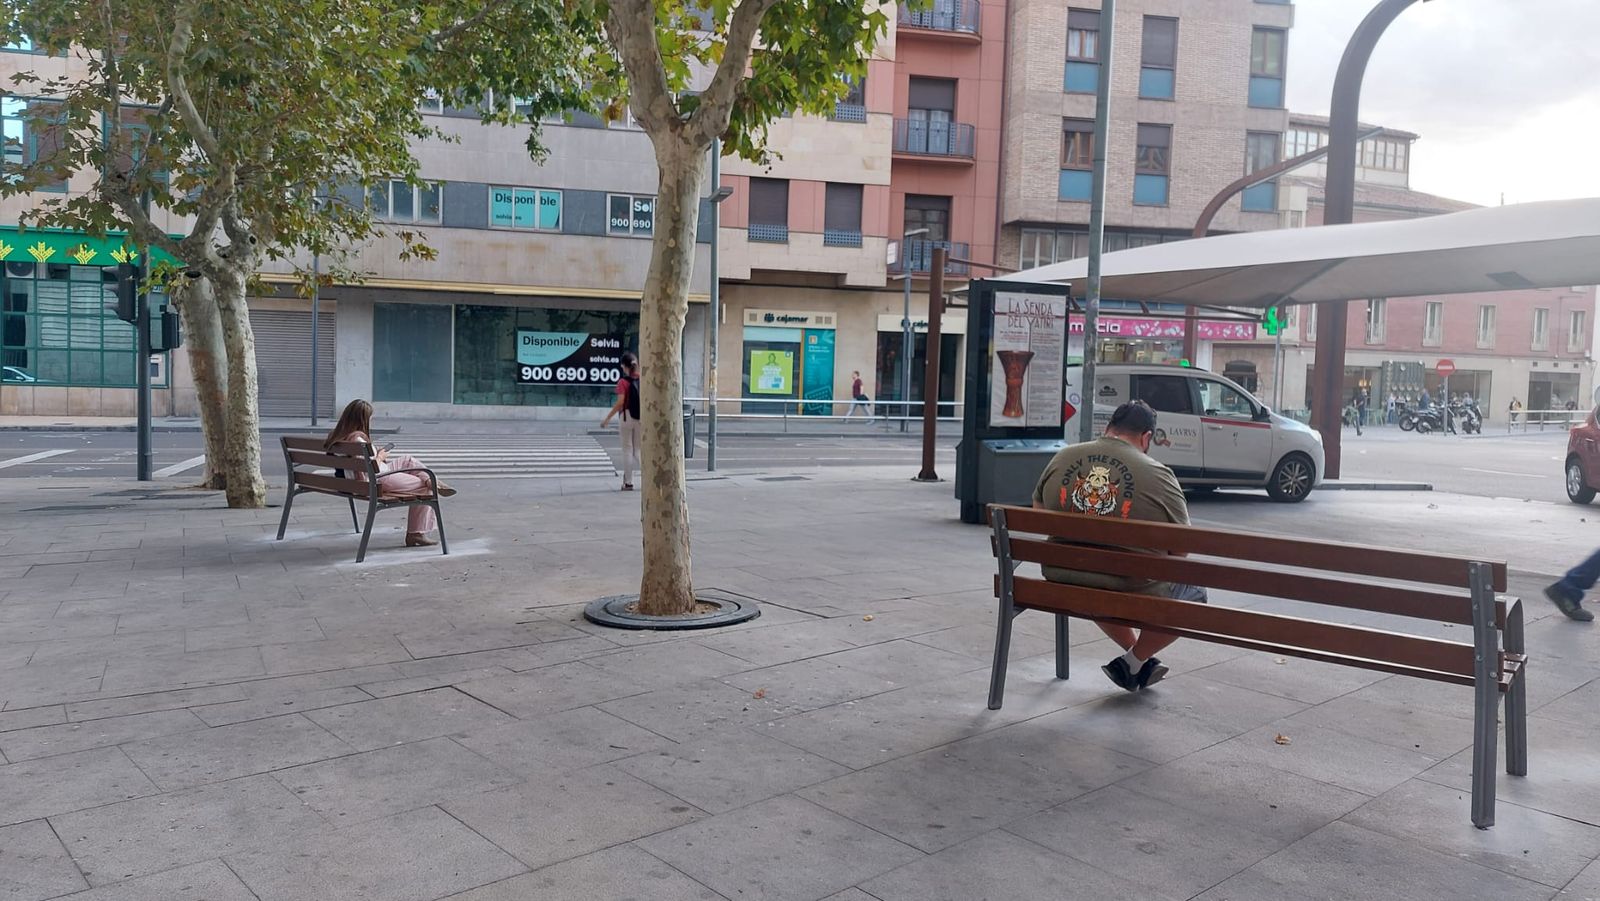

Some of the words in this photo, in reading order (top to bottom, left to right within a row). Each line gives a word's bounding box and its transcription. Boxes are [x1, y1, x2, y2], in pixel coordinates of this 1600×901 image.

[495, 193, 557, 206] Disponible
[634, 201, 652, 213] Sol
[611, 217, 629, 227] 900
[633, 219, 651, 228] 690
[1008, 297, 1020, 314] LA
[1023, 298, 1054, 316] SENDA
[776, 314, 809, 324] cajamar
[1007, 315, 1025, 329] DEL
[522, 335, 580, 348] Disponible
[590, 338, 620, 348] Solvia
[589, 355, 620, 363] solvia.es
[521, 366, 552, 380] 900
[556, 367, 587, 381] 690
[589, 367, 620, 382] 900
[1062, 458, 1083, 486] ONLY
[1088, 454, 1109, 463] THE
[1109, 458, 1135, 499] STRONG
